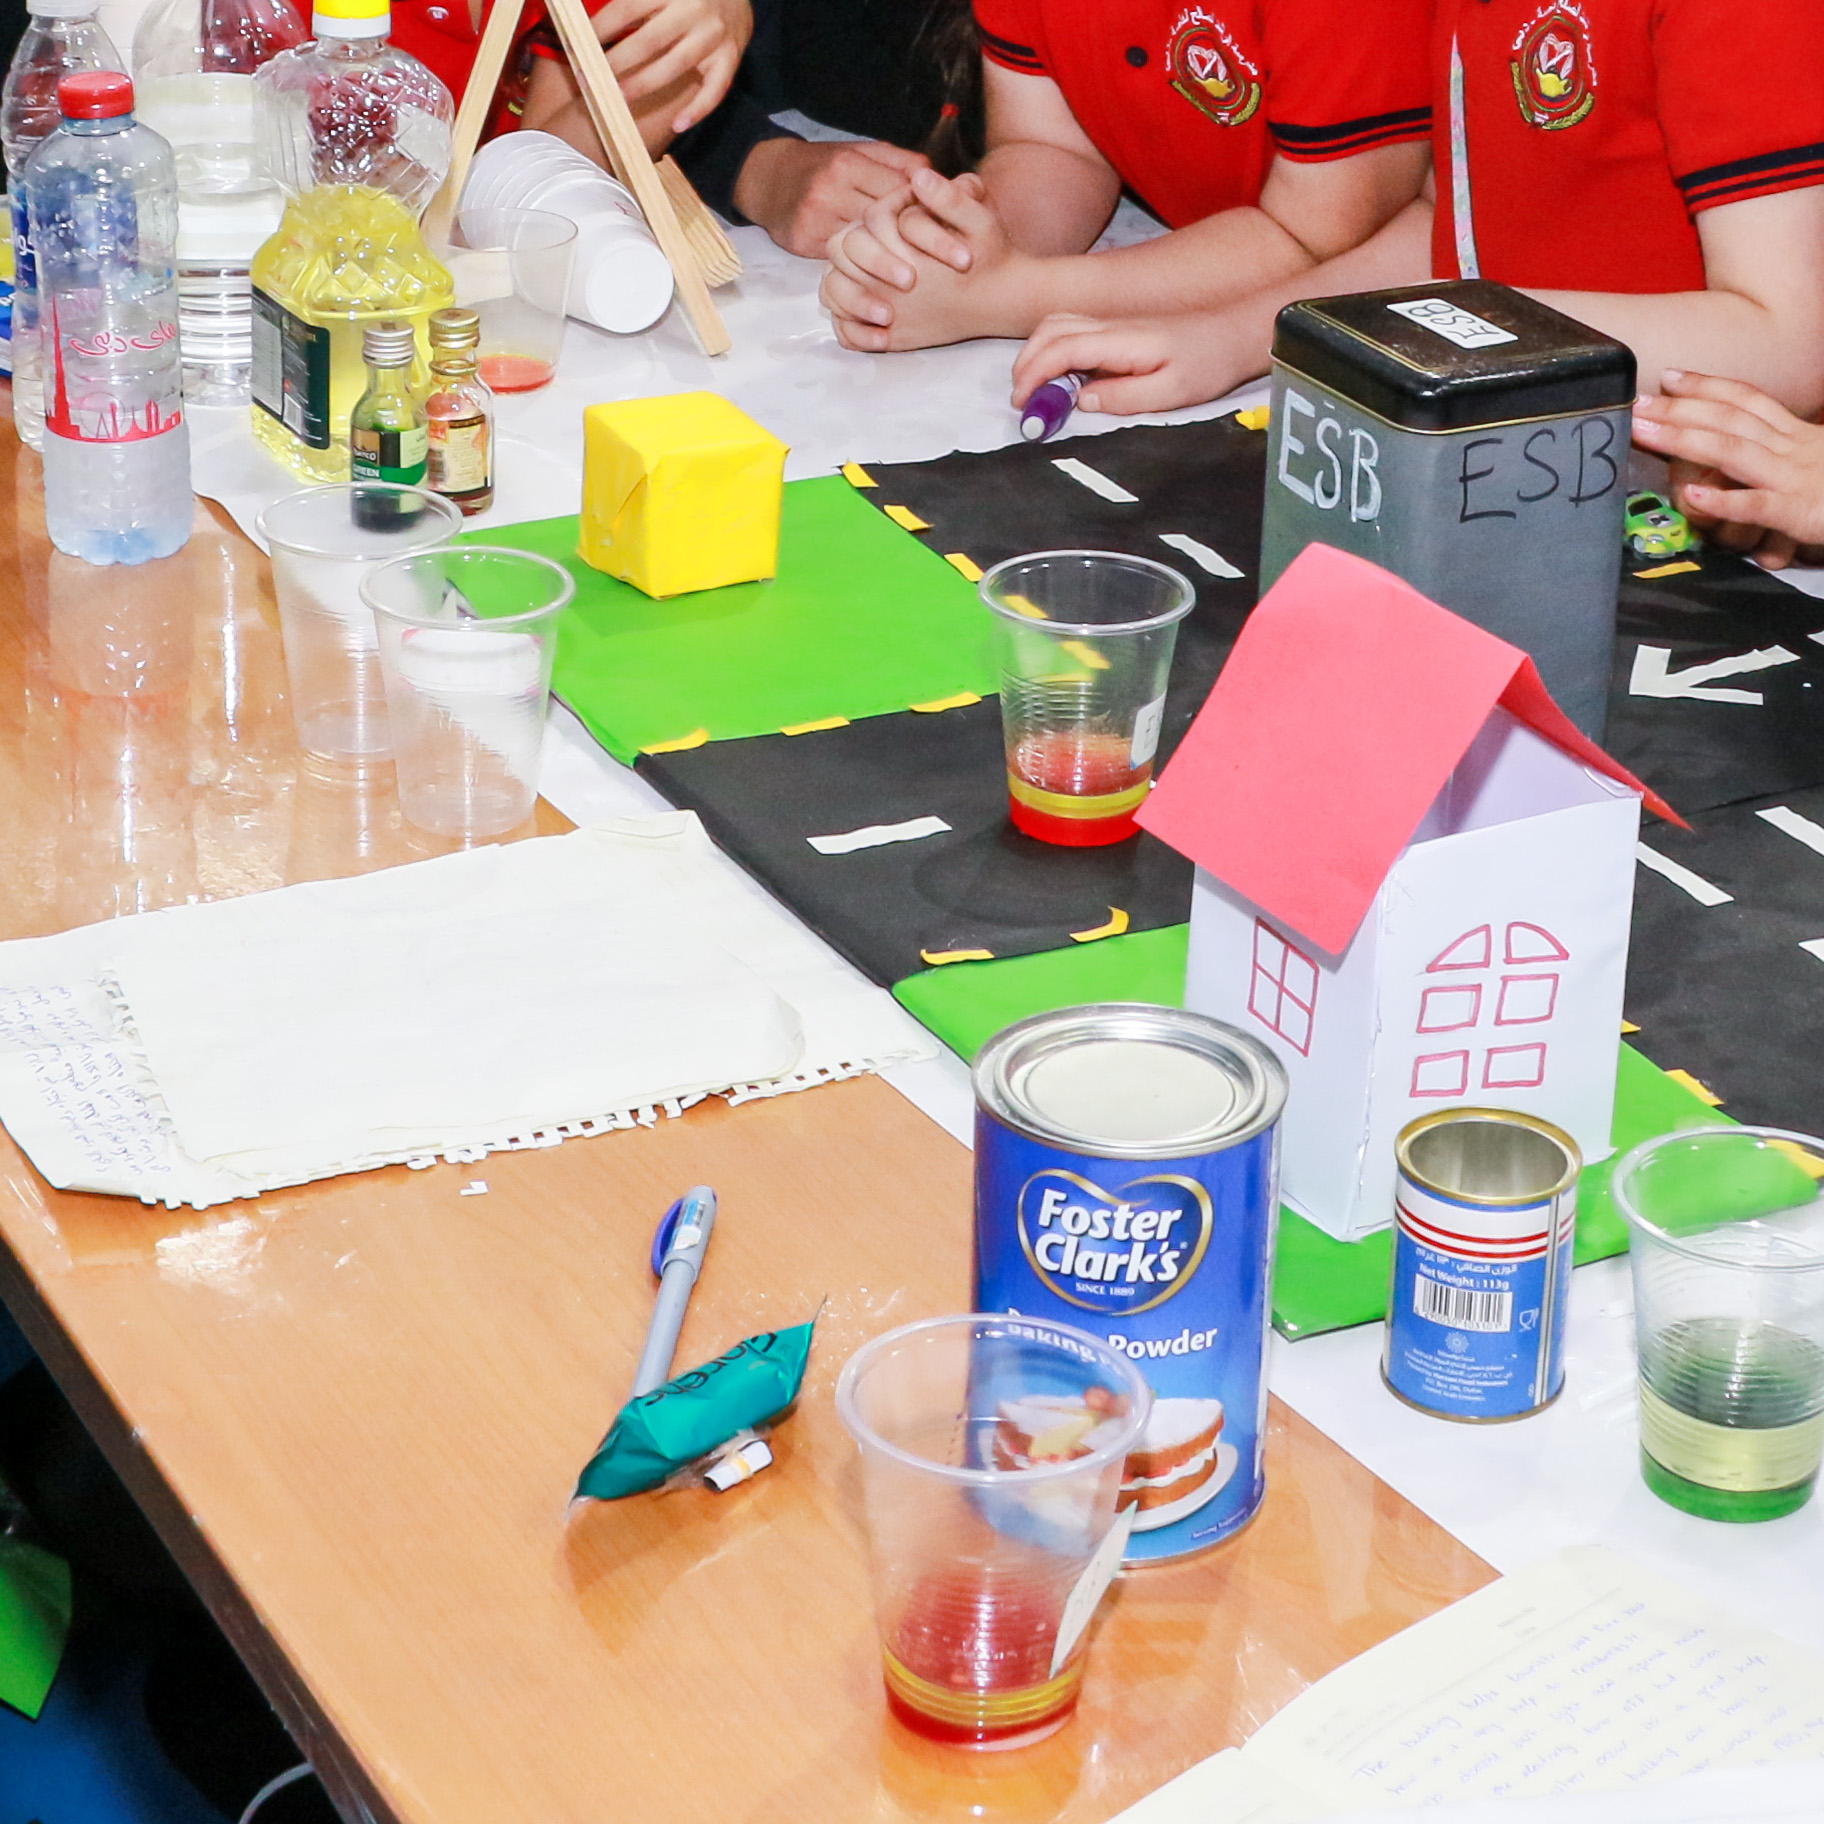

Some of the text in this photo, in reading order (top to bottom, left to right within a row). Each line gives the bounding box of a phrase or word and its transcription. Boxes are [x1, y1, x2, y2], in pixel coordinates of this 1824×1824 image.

[1277, 387, 1383, 524] ESB
[1457, 413, 1619, 525] ESB
[1038, 1188, 1184, 1242] Foster
[1035, 1232, 1180, 1283] Clark's
[1419, 1262, 1436, 1278] Net
[1436, 1269, 1475, 1289] Weight
[1075, 1281, 1106, 1296] SINCE
[1107, 1327, 1219, 1360] Powder
